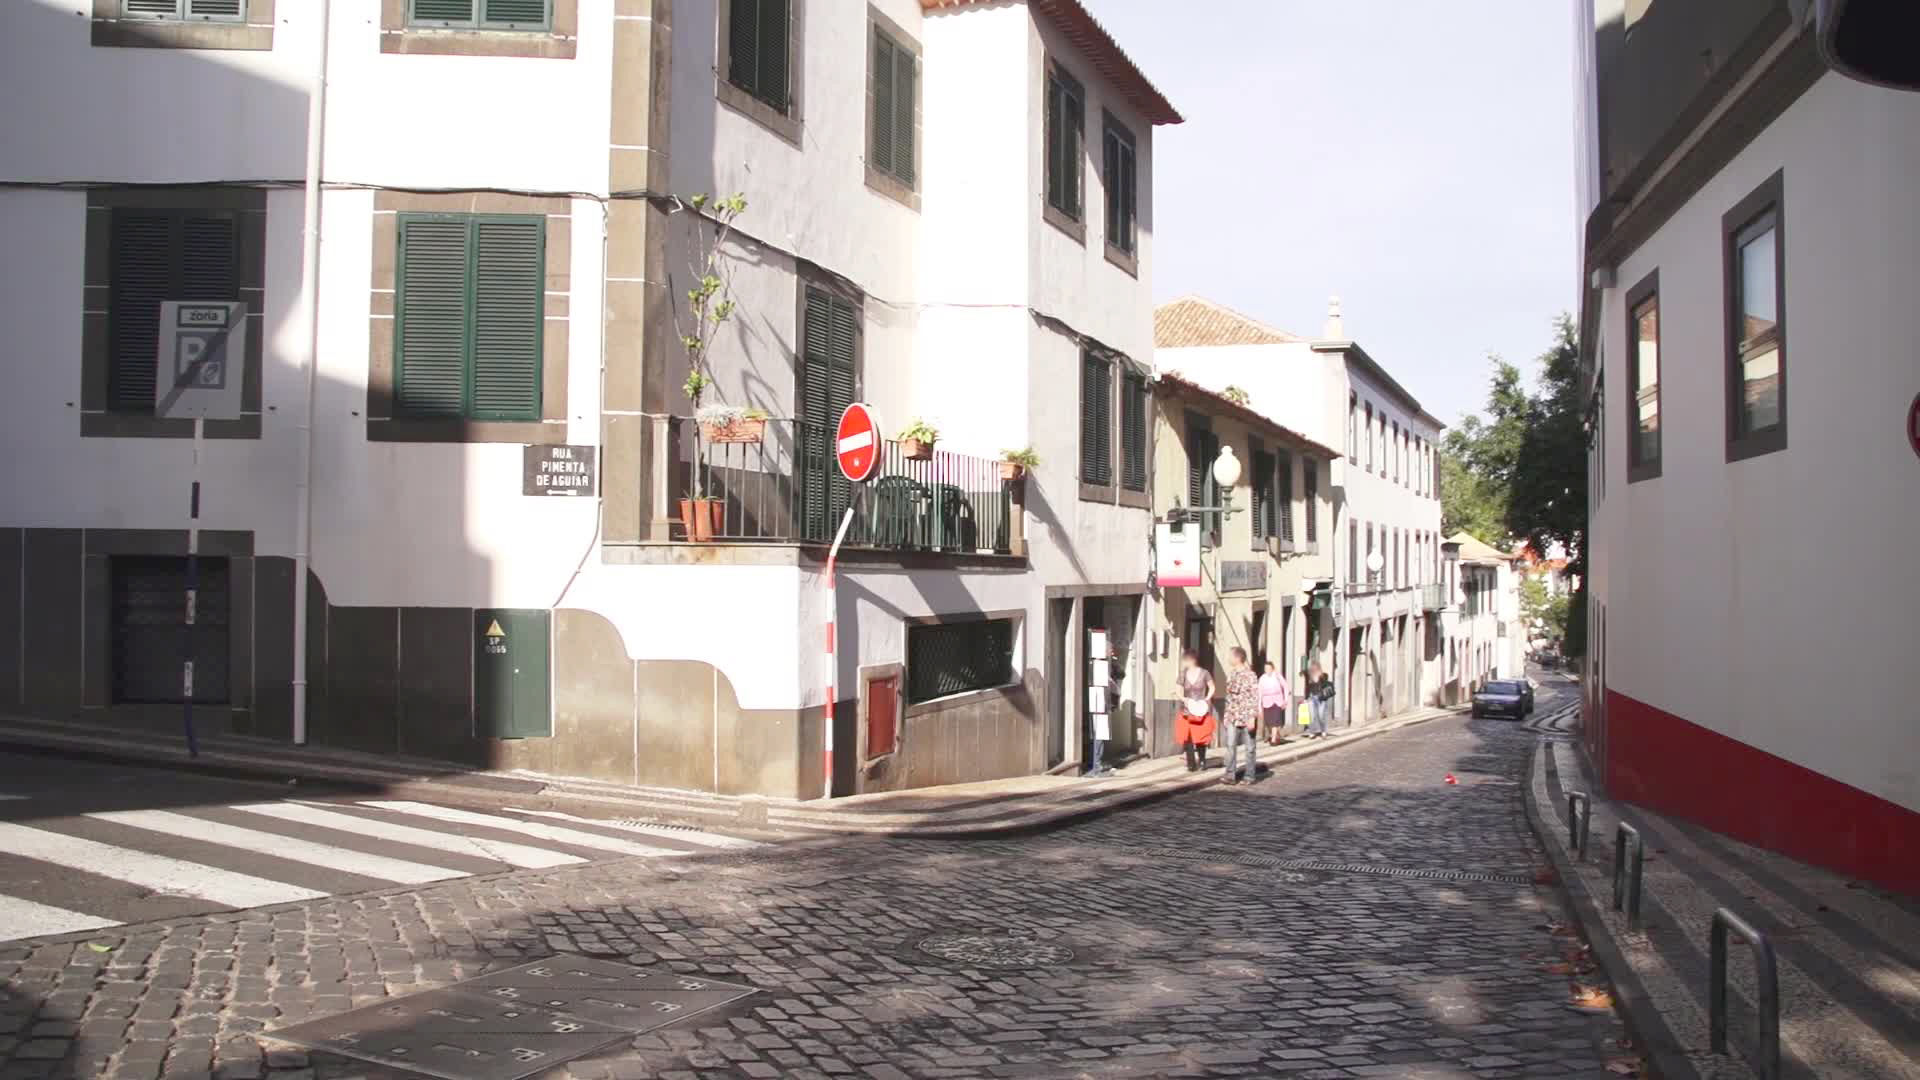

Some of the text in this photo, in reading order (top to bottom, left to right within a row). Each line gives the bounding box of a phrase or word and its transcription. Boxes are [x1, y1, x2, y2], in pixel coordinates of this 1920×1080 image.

[190, 311, 218, 321] zona
[180, 336, 208, 375] P
[552, 447, 572, 459] RUA
[541, 460, 585, 473] PIMENTA
[536, 474, 589, 487] DE AGUIAR
